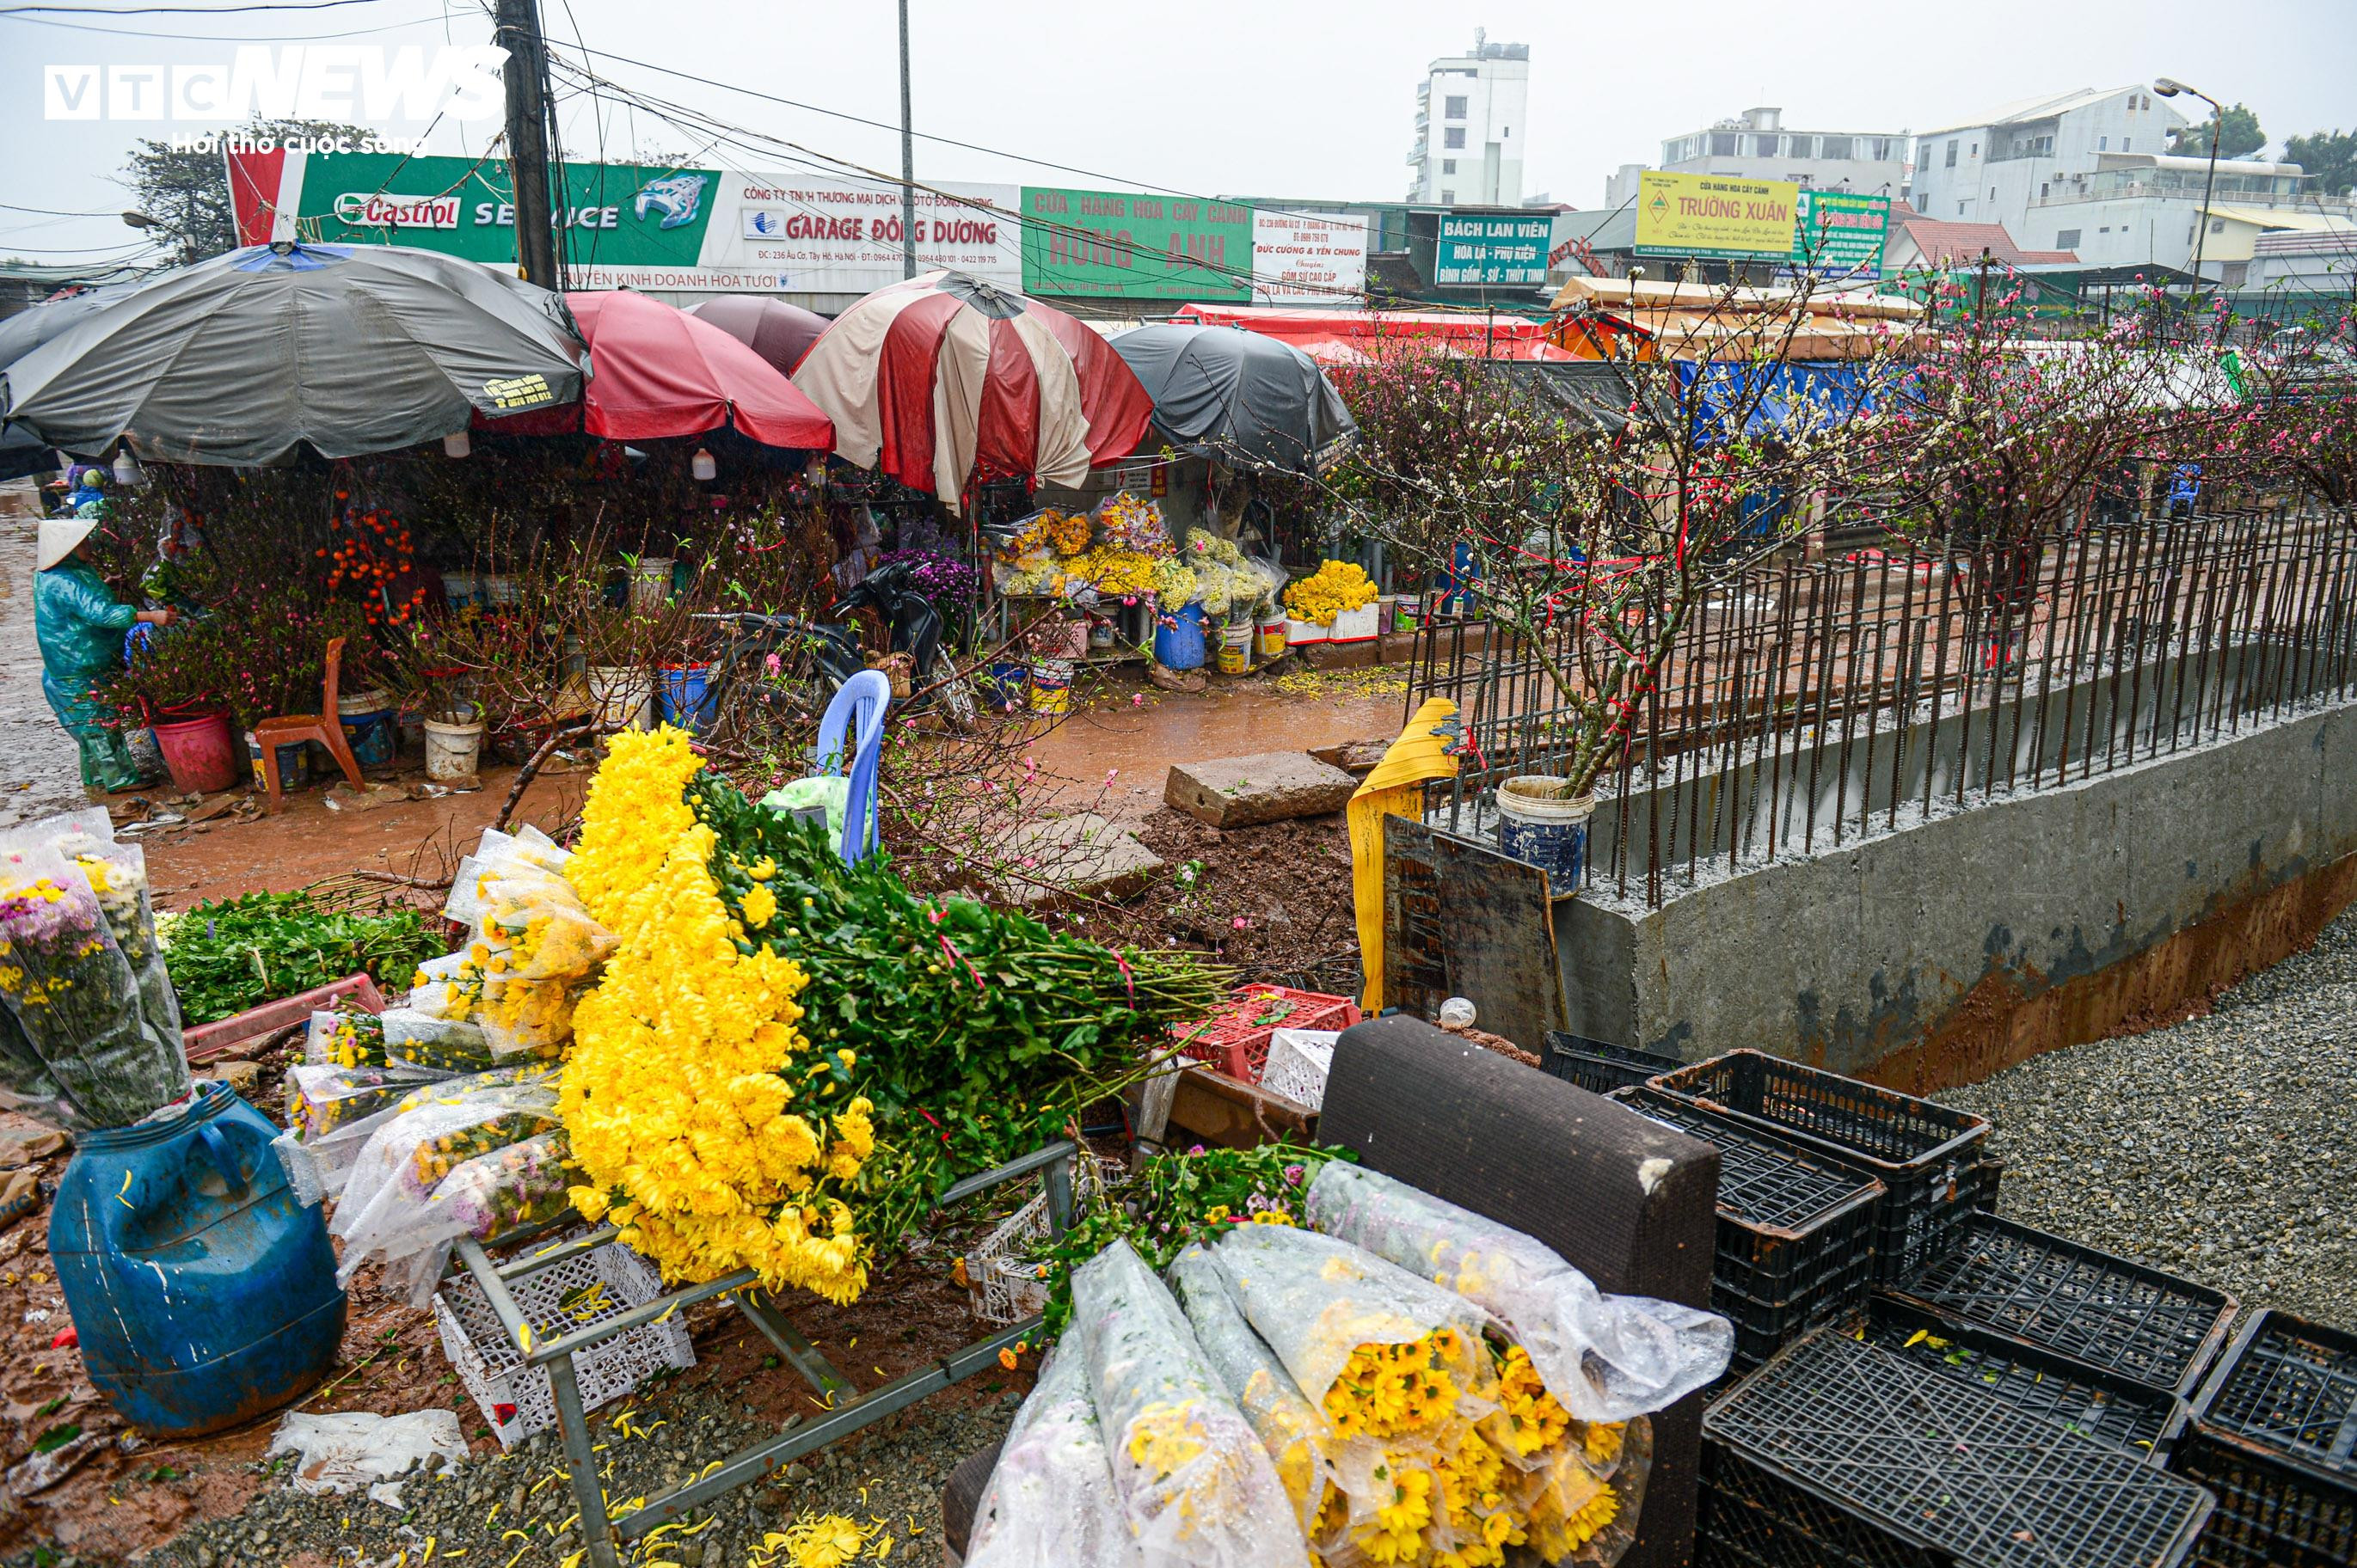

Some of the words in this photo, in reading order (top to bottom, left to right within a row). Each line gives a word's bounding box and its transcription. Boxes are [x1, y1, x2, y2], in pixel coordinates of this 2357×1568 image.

[744, 186, 770, 200] CÔNG
[774, 190, 785, 201] TY
[817, 191, 855, 204] THƯƠNG
[856, 193, 873, 206] MẠI
[875, 194, 896, 207] DỊCH
[1700, 181, 1711, 190] CỬA
[1713, 181, 1728, 192] HÀNG
[1729, 184, 1740, 193] HOA
[1742, 183, 1752, 193] CÂY
[365, 198, 457, 224] Castrol
[475, 203, 619, 229] SEICE
[1034, 189, 1068, 214] CỬA
[1081, 194, 1125, 217] HÀNG
[1132, 199, 1163, 221] HOA
[1172, 200, 1200, 222] CÂY
[1207, 200, 1248, 225] CẢNH
[1679, 195, 1740, 219] TRƯỜNG
[1746, 200, 1788, 222] XUÂN
[786, 215, 863, 241] GARAGE
[933, 218, 997, 244] DƯƠNG
[1444, 219, 1483, 236] BÁCH
[1486, 223, 1514, 238] LAN
[1517, 221, 1549, 238] VIÊN
[758, 250, 771, 259] ĐC:
[773, 250, 785, 259] 236
[809, 252, 820, 262] Tây
[874, 254, 891, 262] 0964
[1165, 232, 1226, 272] ANH
[1256, 242, 1274, 253] ĐỨC
[1306, 247, 1313, 255] &
[1333, 248, 1361, 257] CHUNG
[1453, 244, 1472, 259] HOA
[1474, 243, 1487, 260] LÁ
[1494, 246, 1514, 263] PHỤ
[1514, 244, 1538, 264] KIỆN
[557, 270, 612, 285] UYÊN
[617, 273, 652, 285] KINH
[655, 273, 707, 287] DOANH
[710, 274, 741, 287] HOA
[744, 273, 777, 288] TƯƠI
[1309, 273, 1322, 283] CAO
[1439, 265, 1460, 282] BÌNH
[1461, 264, 1482, 283] GỐM
[1505, 265, 1525, 283] THỦY
[1526, 268, 1546, 283] TINH
[1256, 285, 1271, 295] HOA
